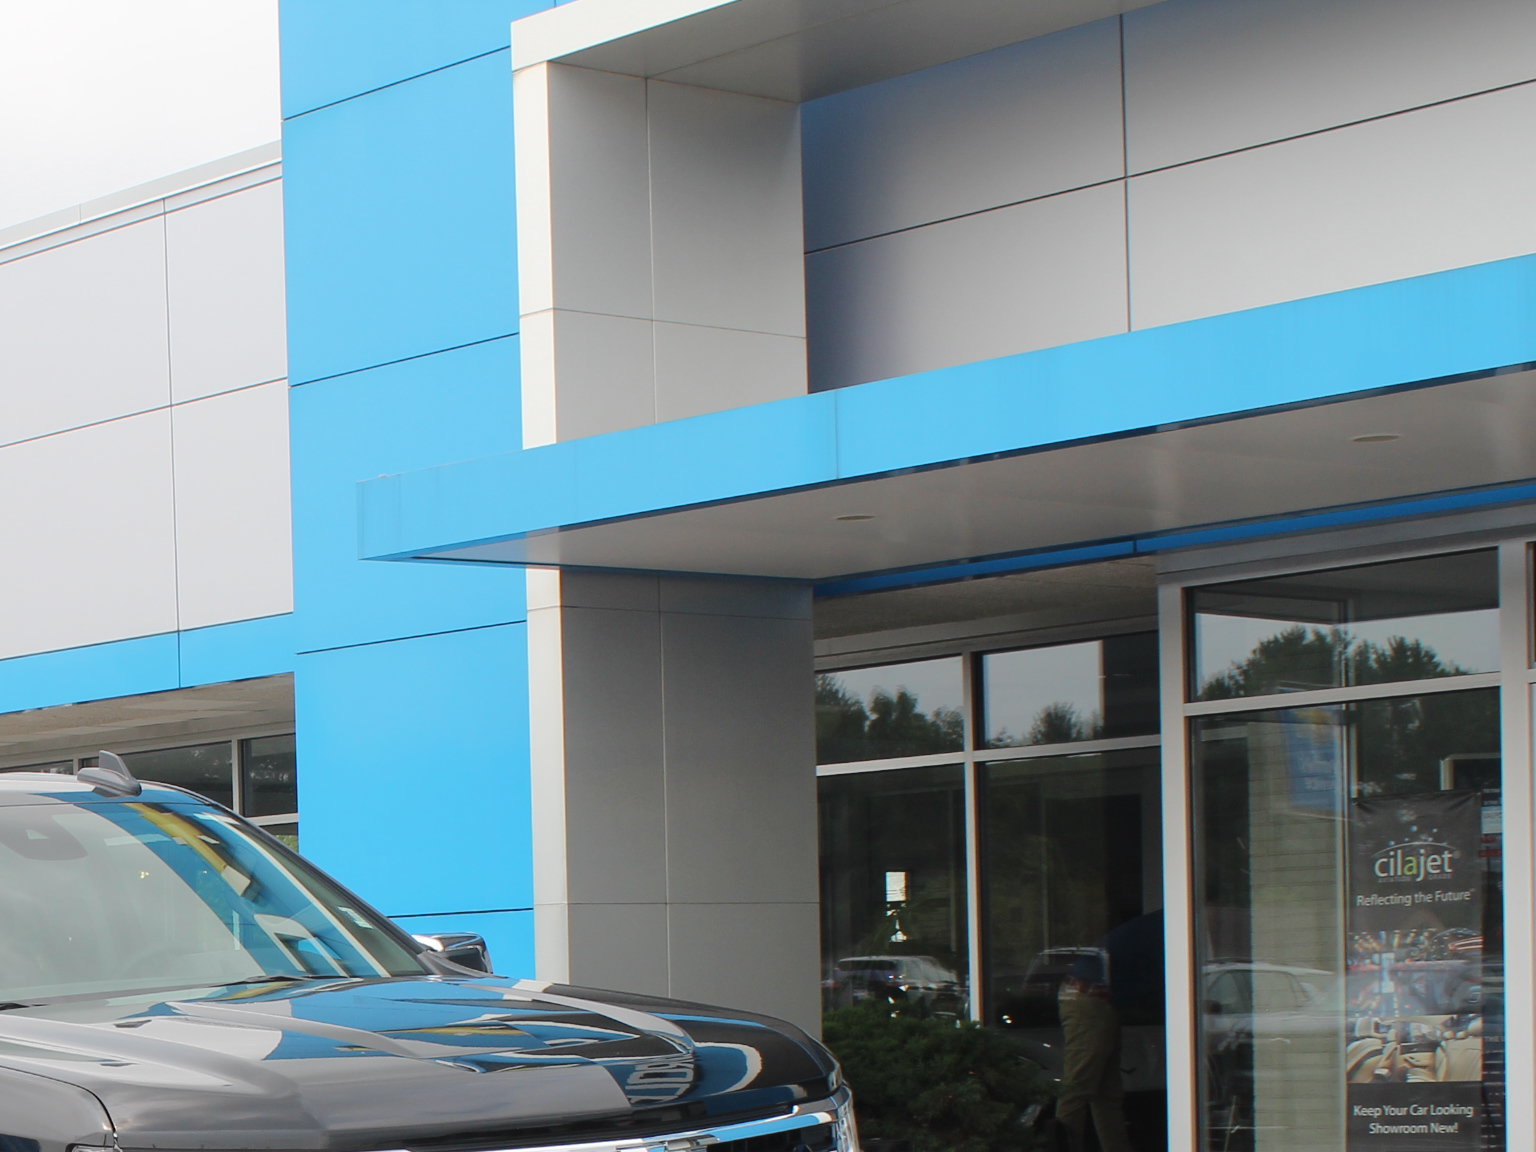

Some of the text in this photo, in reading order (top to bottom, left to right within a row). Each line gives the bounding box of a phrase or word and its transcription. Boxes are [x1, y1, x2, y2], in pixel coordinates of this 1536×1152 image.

[1374, 849, 1453, 882] cilajet
[1356, 893, 1412, 907] Reflecting
[1414, 891, 1433, 903] the
[1353, 1103, 1474, 1118] Keep Your Car Looking
[1369, 1122, 1459, 1134] Showroom New!
